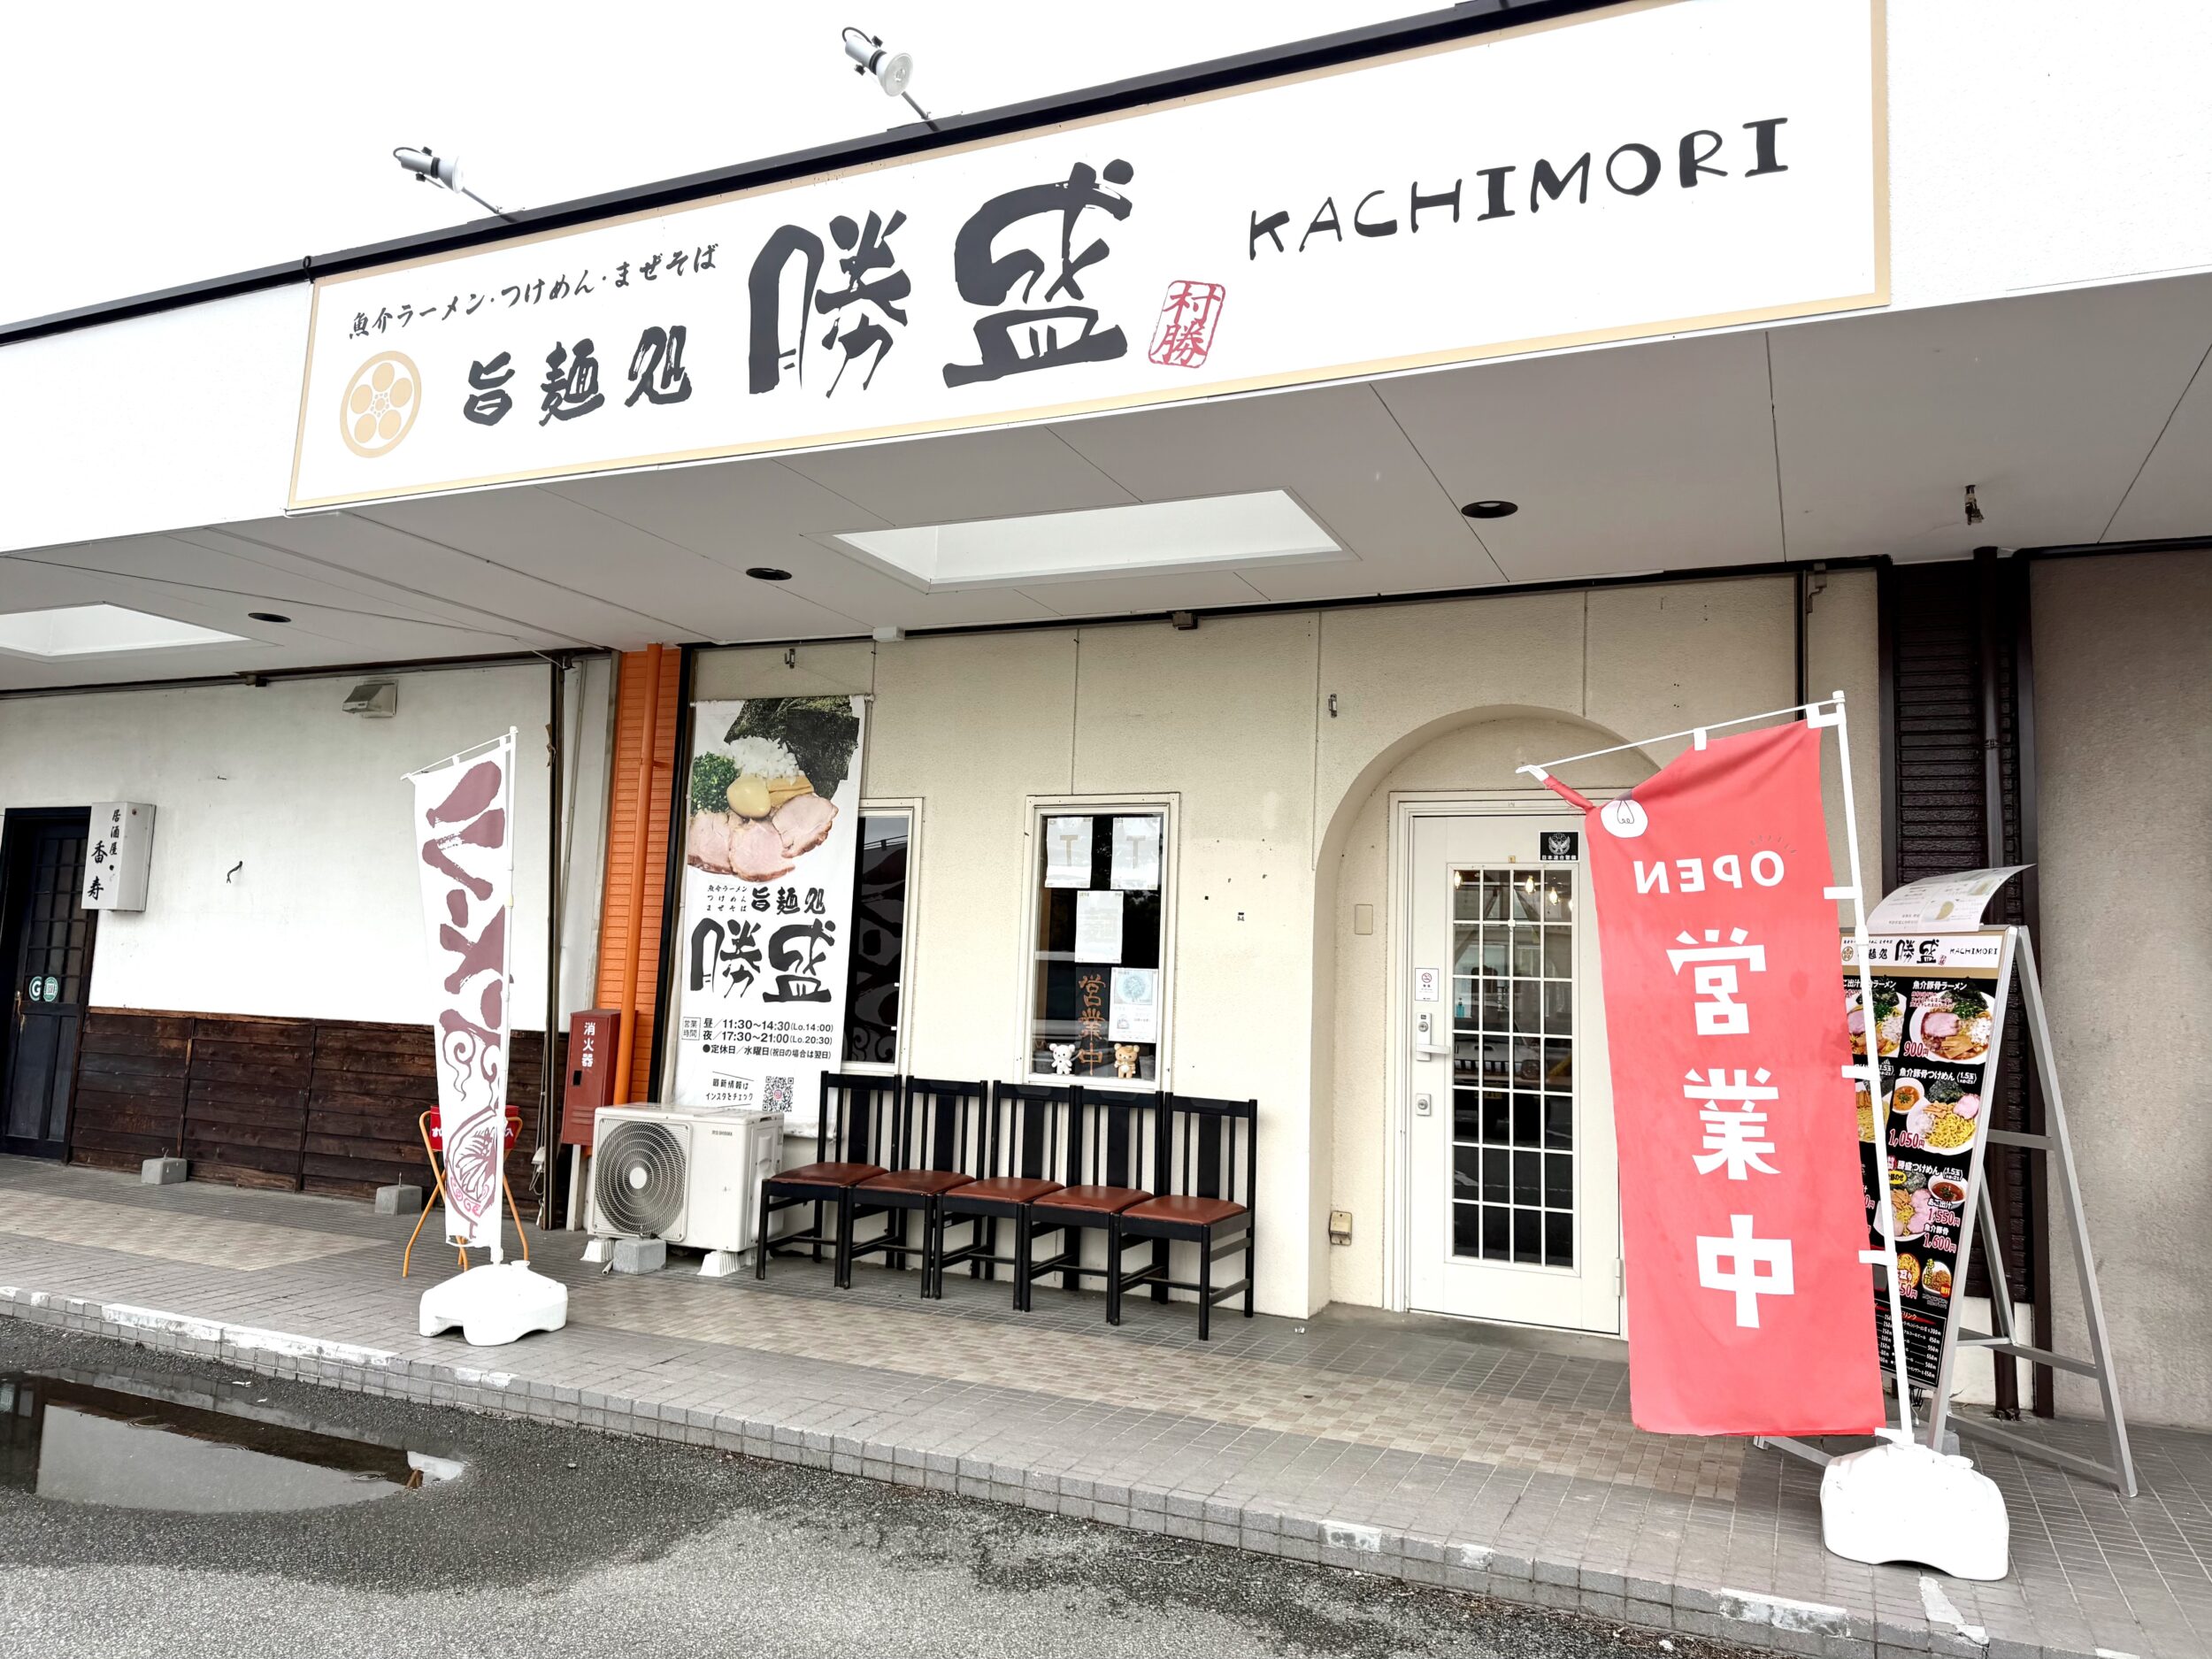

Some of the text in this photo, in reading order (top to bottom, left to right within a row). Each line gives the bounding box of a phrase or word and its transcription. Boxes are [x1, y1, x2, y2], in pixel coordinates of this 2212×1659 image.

[1248, 116, 1789, 260] KACHIMORI
[749, 158, 1134, 398] 勝盛
[1150, 281, 1223, 365] 村勝
[464, 325, 692, 426] 旨麺処
[109, 809, 121, 856] 居酒屋
[707, 895, 747, 903] つけめん
[751, 886, 826, 915] 旨麺処
[690, 918, 836, 1002] 勝盛
[1894, 939, 1939, 964] 勝盛
[1912, 980, 1968, 991] 魚介豚骨ラーメン
[683, 1029, 697, 1038] 時間
[684, 1019, 698, 1028] 営業
[1077, 973, 1106, 1077] 営業中
[581, 1022, 596, 1068] 消火器
[1903, 1041, 1929, 1057] 900円
[712, 1078, 749, 1090] 最新情報は
[1899, 1067, 1955, 1081] 魚介豚骨つけめん
[705, 1092, 753, 1101] インスタをチェック
[1888, 1128, 1924, 1149] 1,050円
[1928, 1208, 1961, 1228] 1,550円
[1924, 1223, 1949, 1236] 魚介豚骨
[1923, 1233, 1956, 1254] 1,600円
